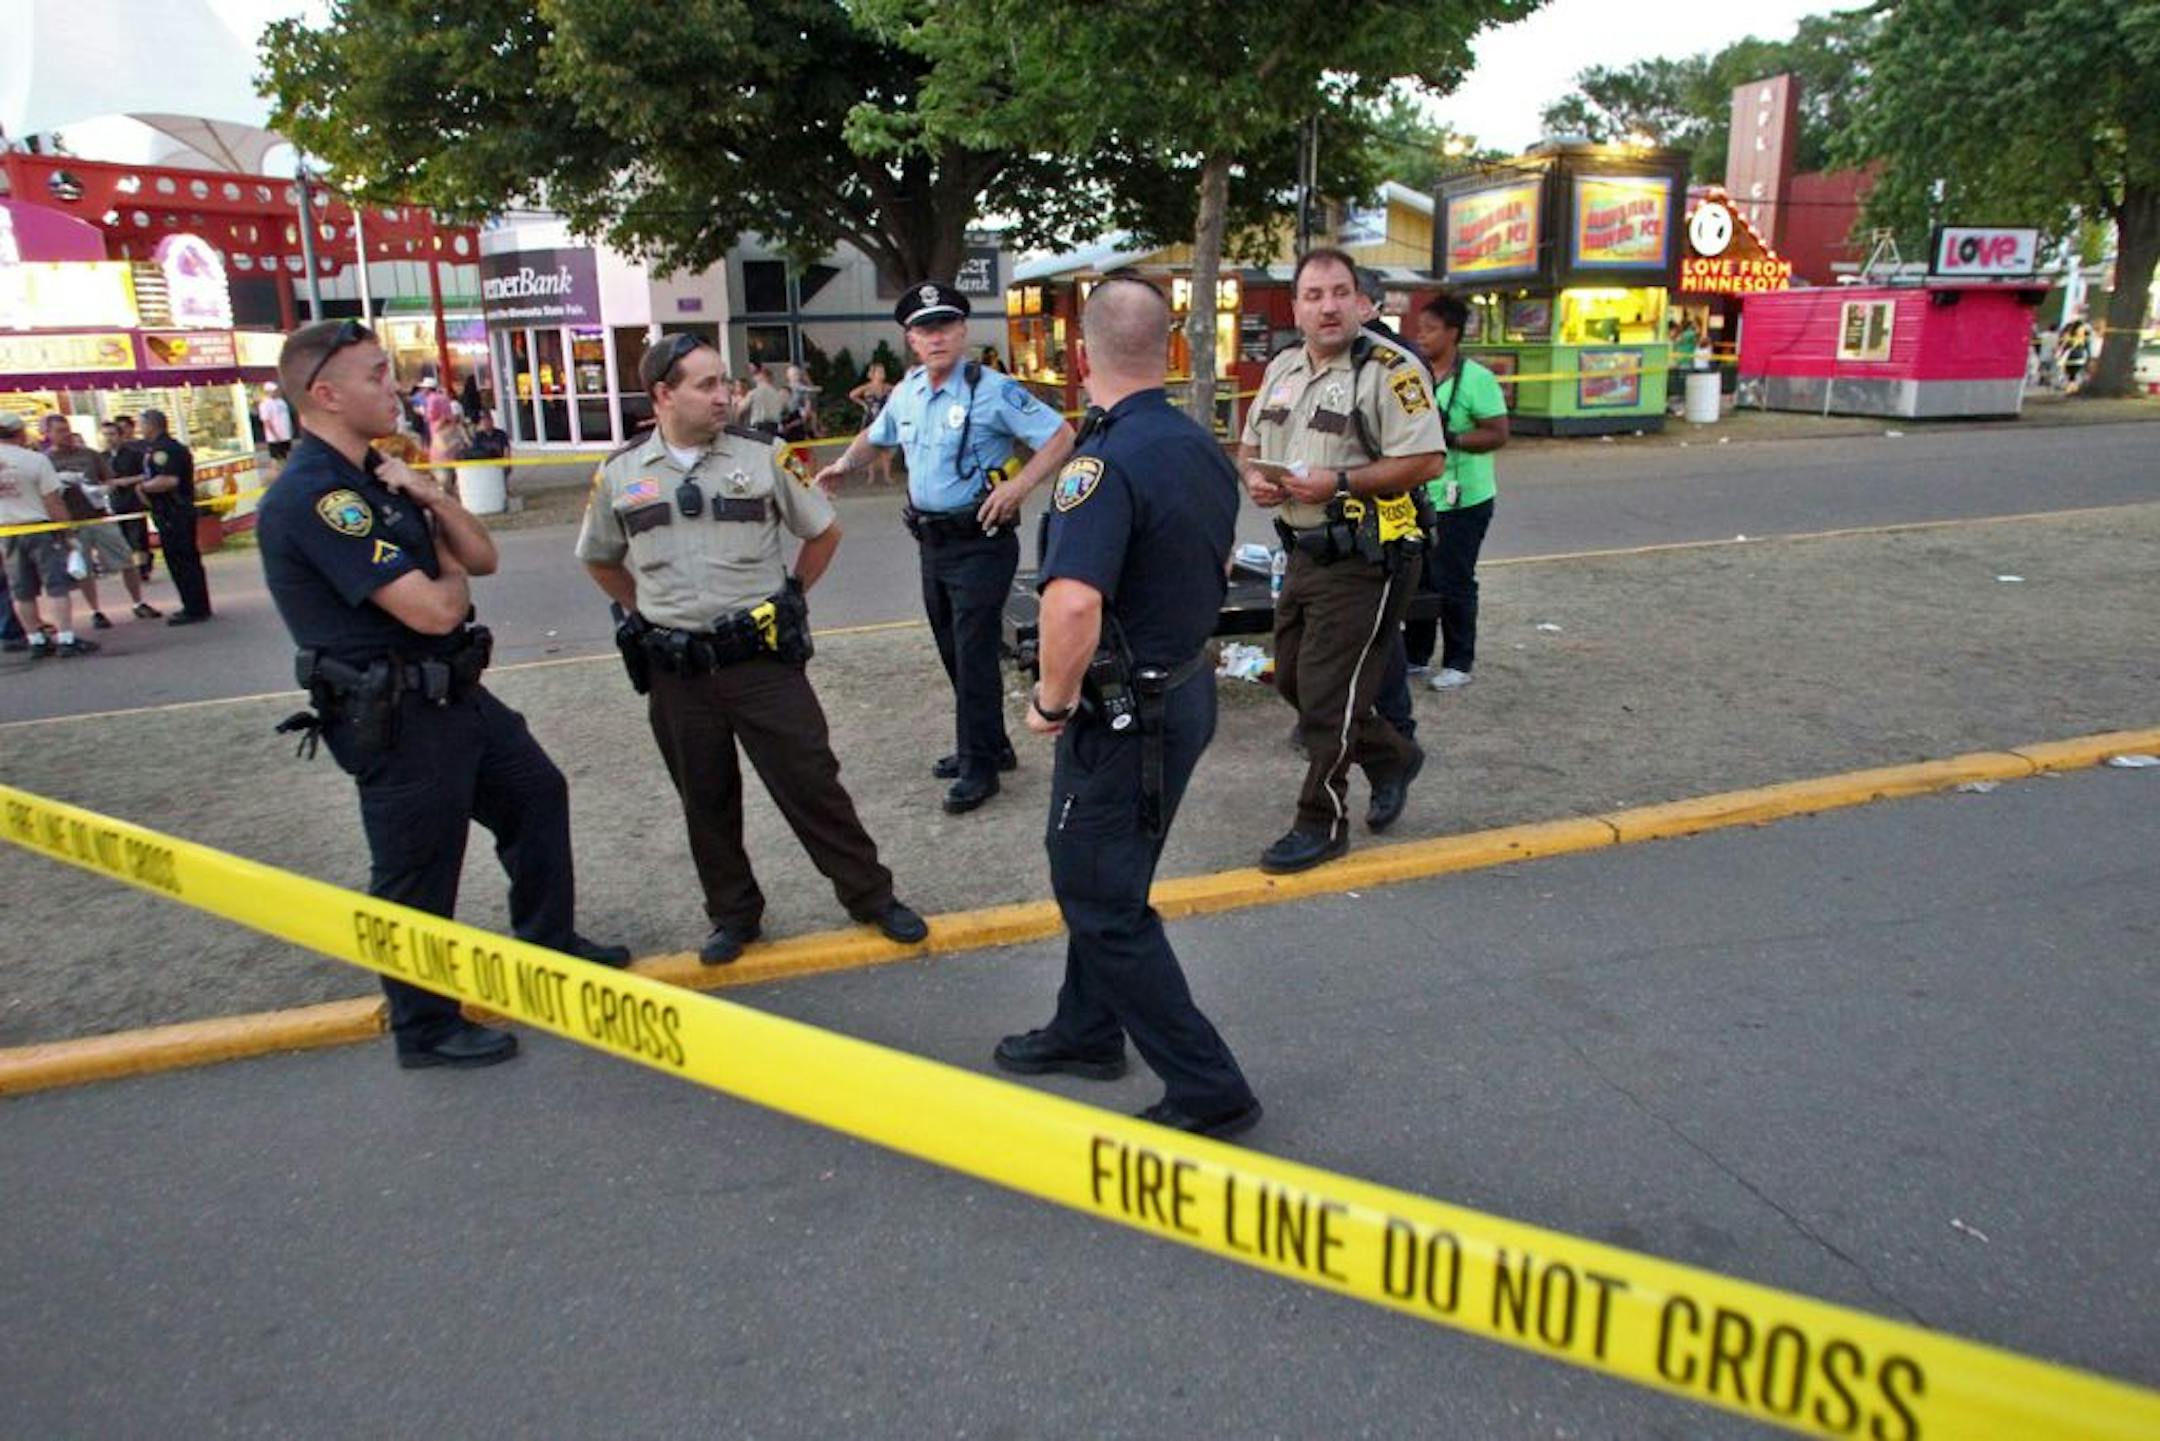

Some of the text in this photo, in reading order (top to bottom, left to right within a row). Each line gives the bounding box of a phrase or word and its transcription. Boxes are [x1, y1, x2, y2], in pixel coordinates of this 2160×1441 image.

[1681, 275, 1790, 293] MINNESOTA
[1682, 259, 1792, 278] LOVE FROM
[354, 910, 685, 1067] FIRE LINE DO NOT CROSS
[1091, 1134, 1926, 1441] FIRE LINE DO NOT CROSS
